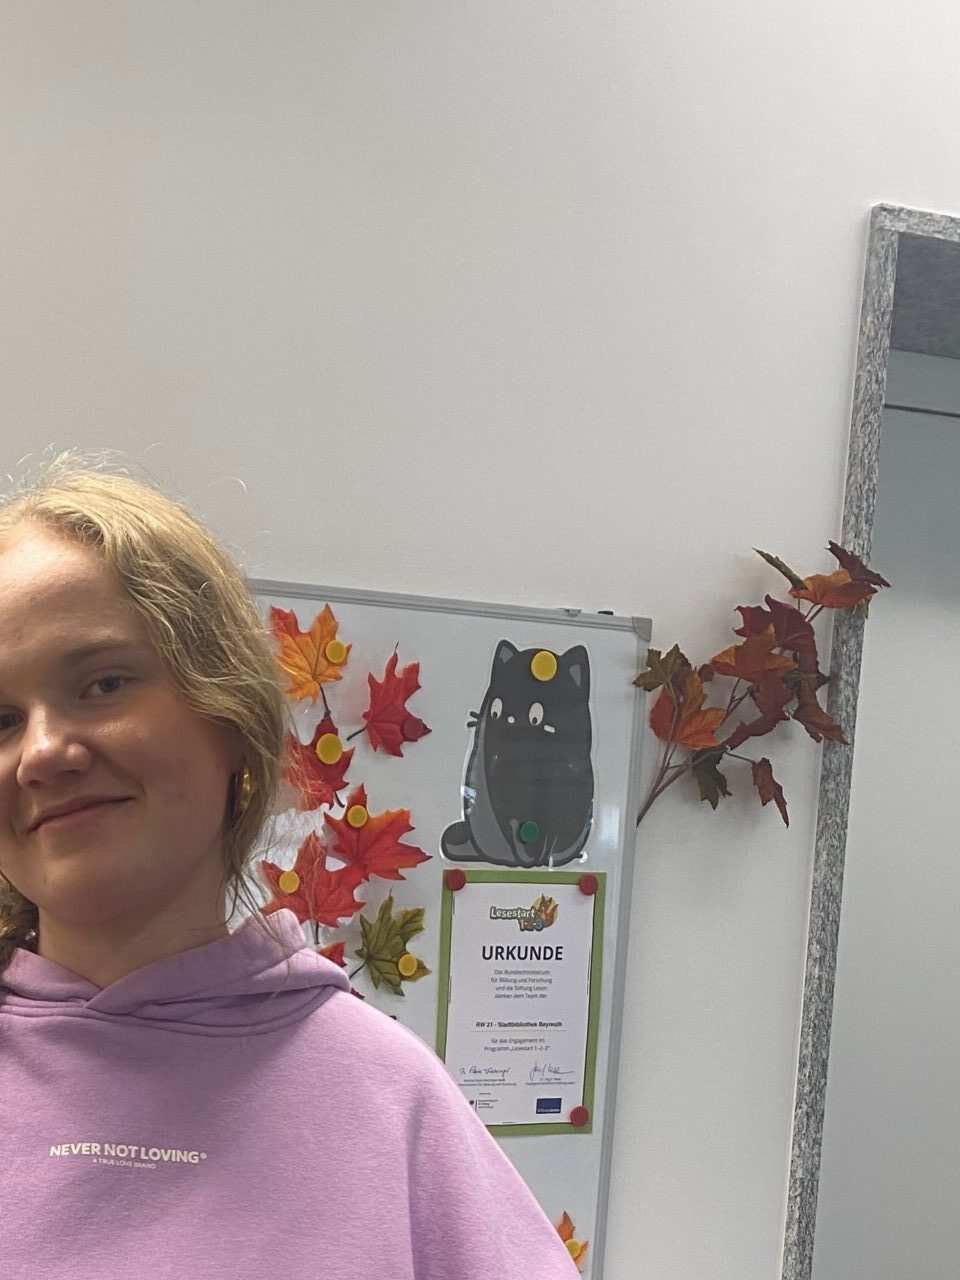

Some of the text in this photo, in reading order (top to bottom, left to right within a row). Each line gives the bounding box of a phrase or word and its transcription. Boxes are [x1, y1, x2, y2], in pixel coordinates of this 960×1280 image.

[490, 906, 536, 919] Lesestart
[482, 945, 563, 961] URKUNDE
[49, 1143, 101, 1157] NEVER
[104, 1144, 139, 1158] NOT
